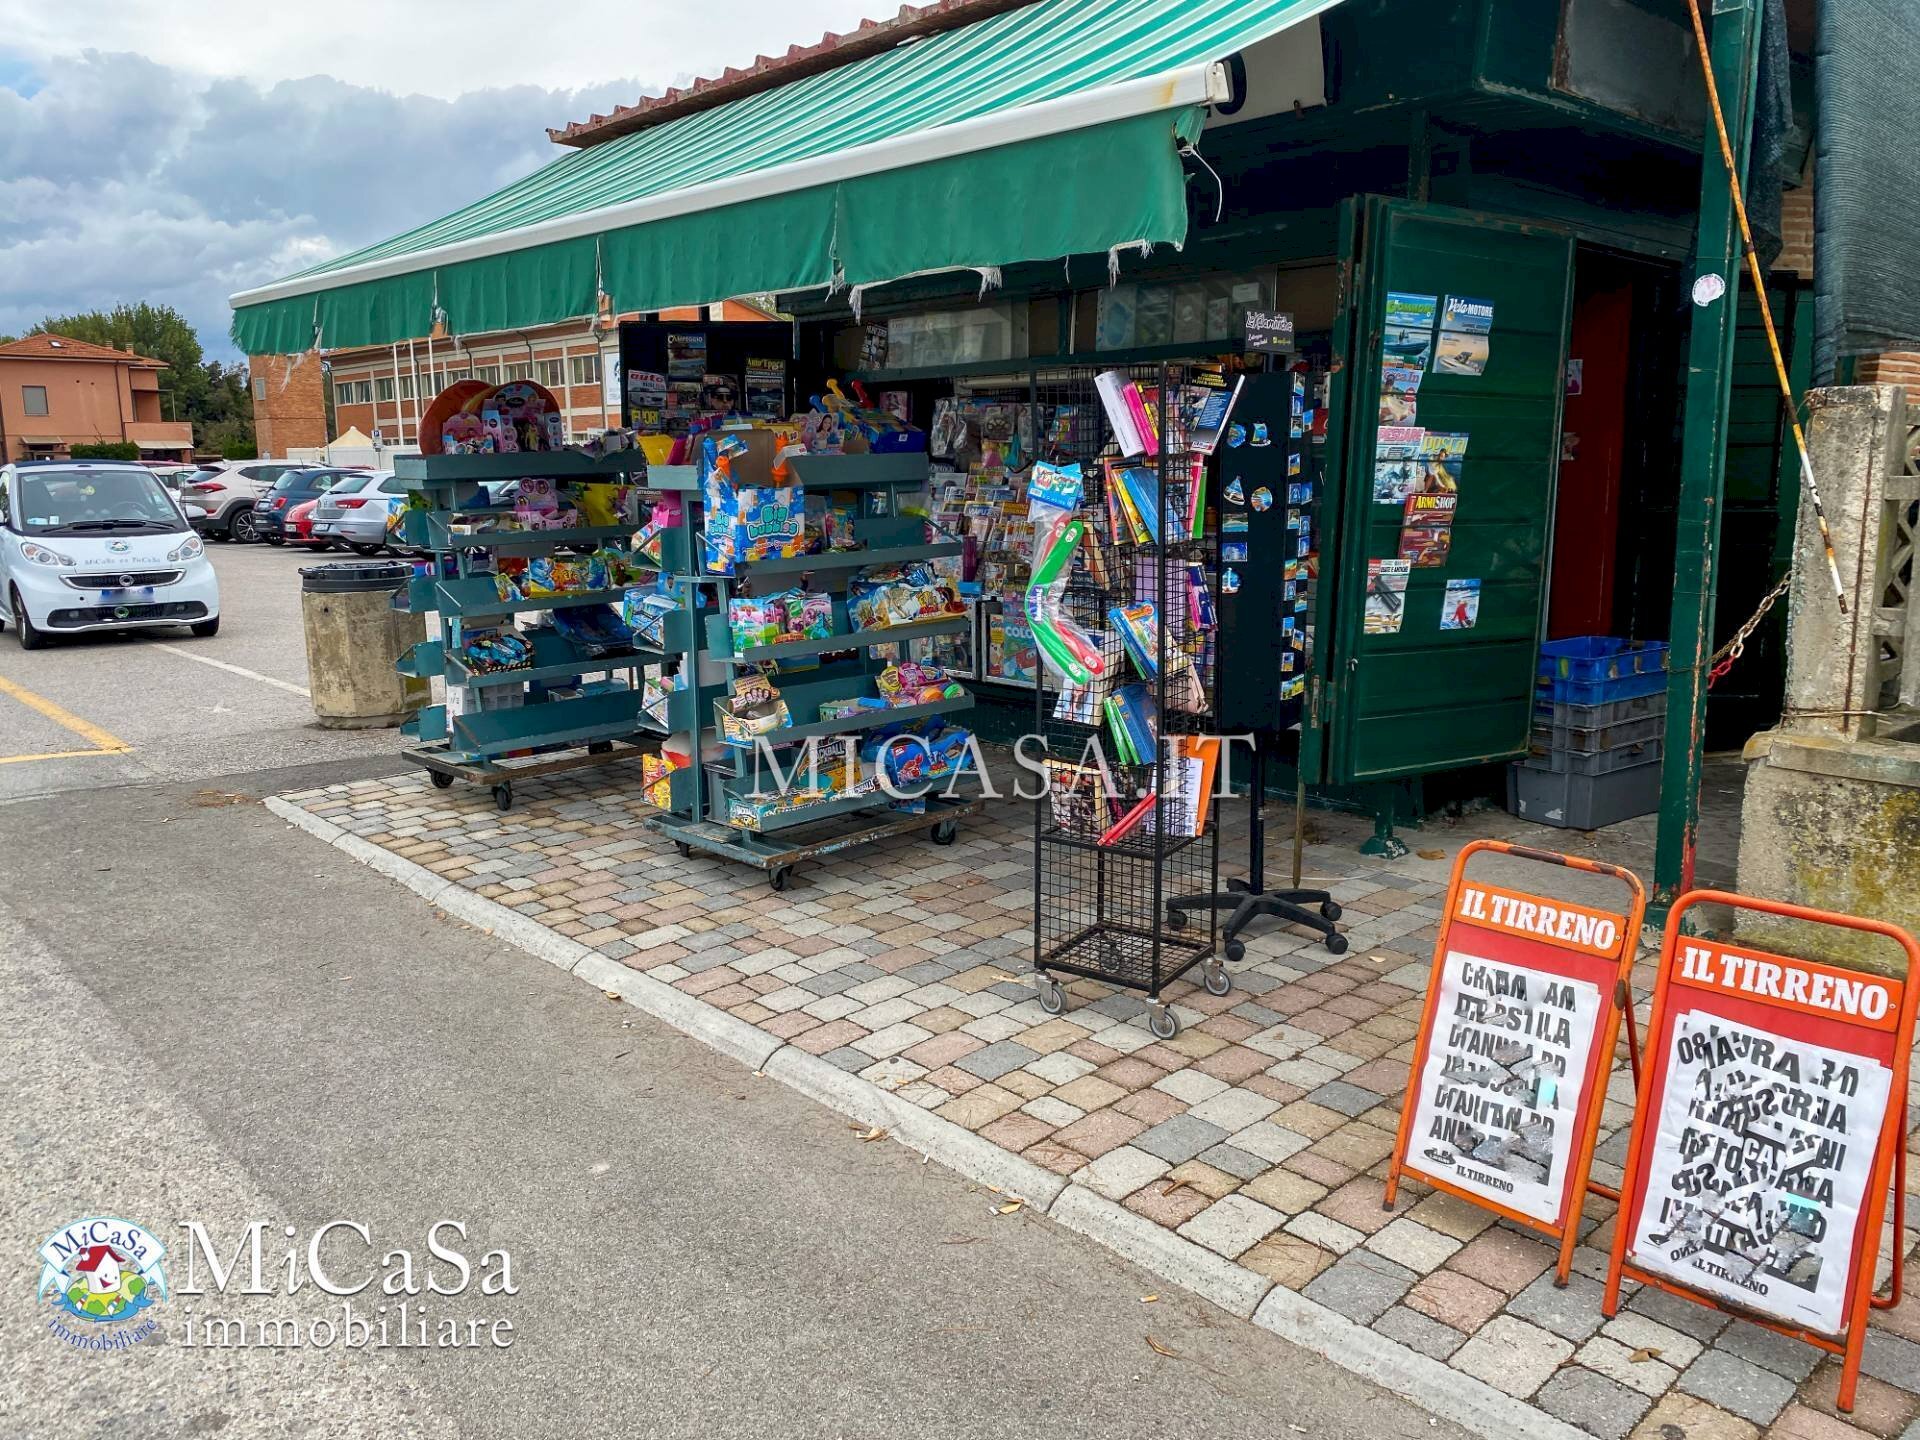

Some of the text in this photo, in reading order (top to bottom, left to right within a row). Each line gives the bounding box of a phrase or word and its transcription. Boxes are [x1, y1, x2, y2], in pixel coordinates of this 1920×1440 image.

[1460, 889, 1616, 951] IL TIRRENO
[1681, 946, 1889, 1021] IL TIRRENO
[1467, 1168, 1515, 1193] TIRRENO
